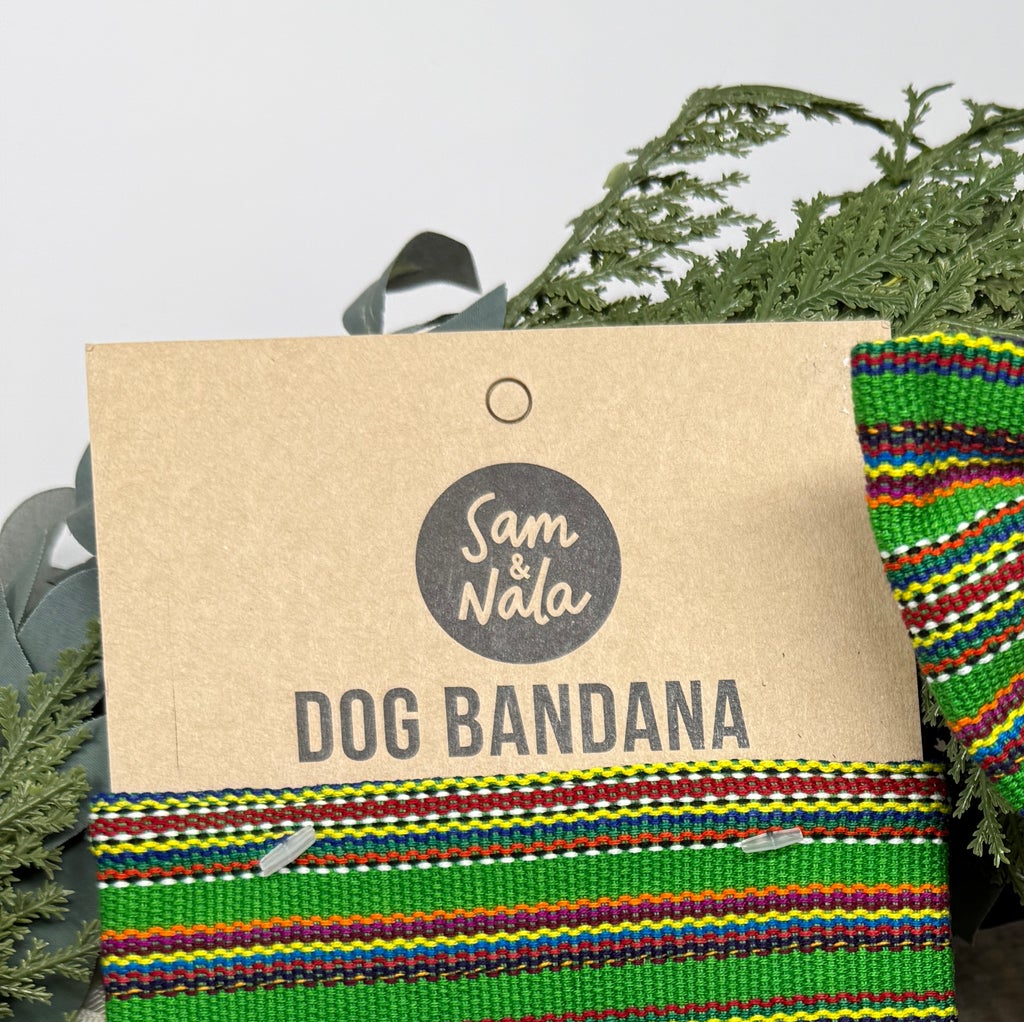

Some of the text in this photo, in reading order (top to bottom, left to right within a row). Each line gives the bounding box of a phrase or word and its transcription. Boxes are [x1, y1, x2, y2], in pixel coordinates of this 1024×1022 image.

[461, 492, 579, 563] Sam
[457, 557, 592, 625] Nala
[509, 552, 531, 581] &
[294, 679, 750, 763] DOG BANDANA
